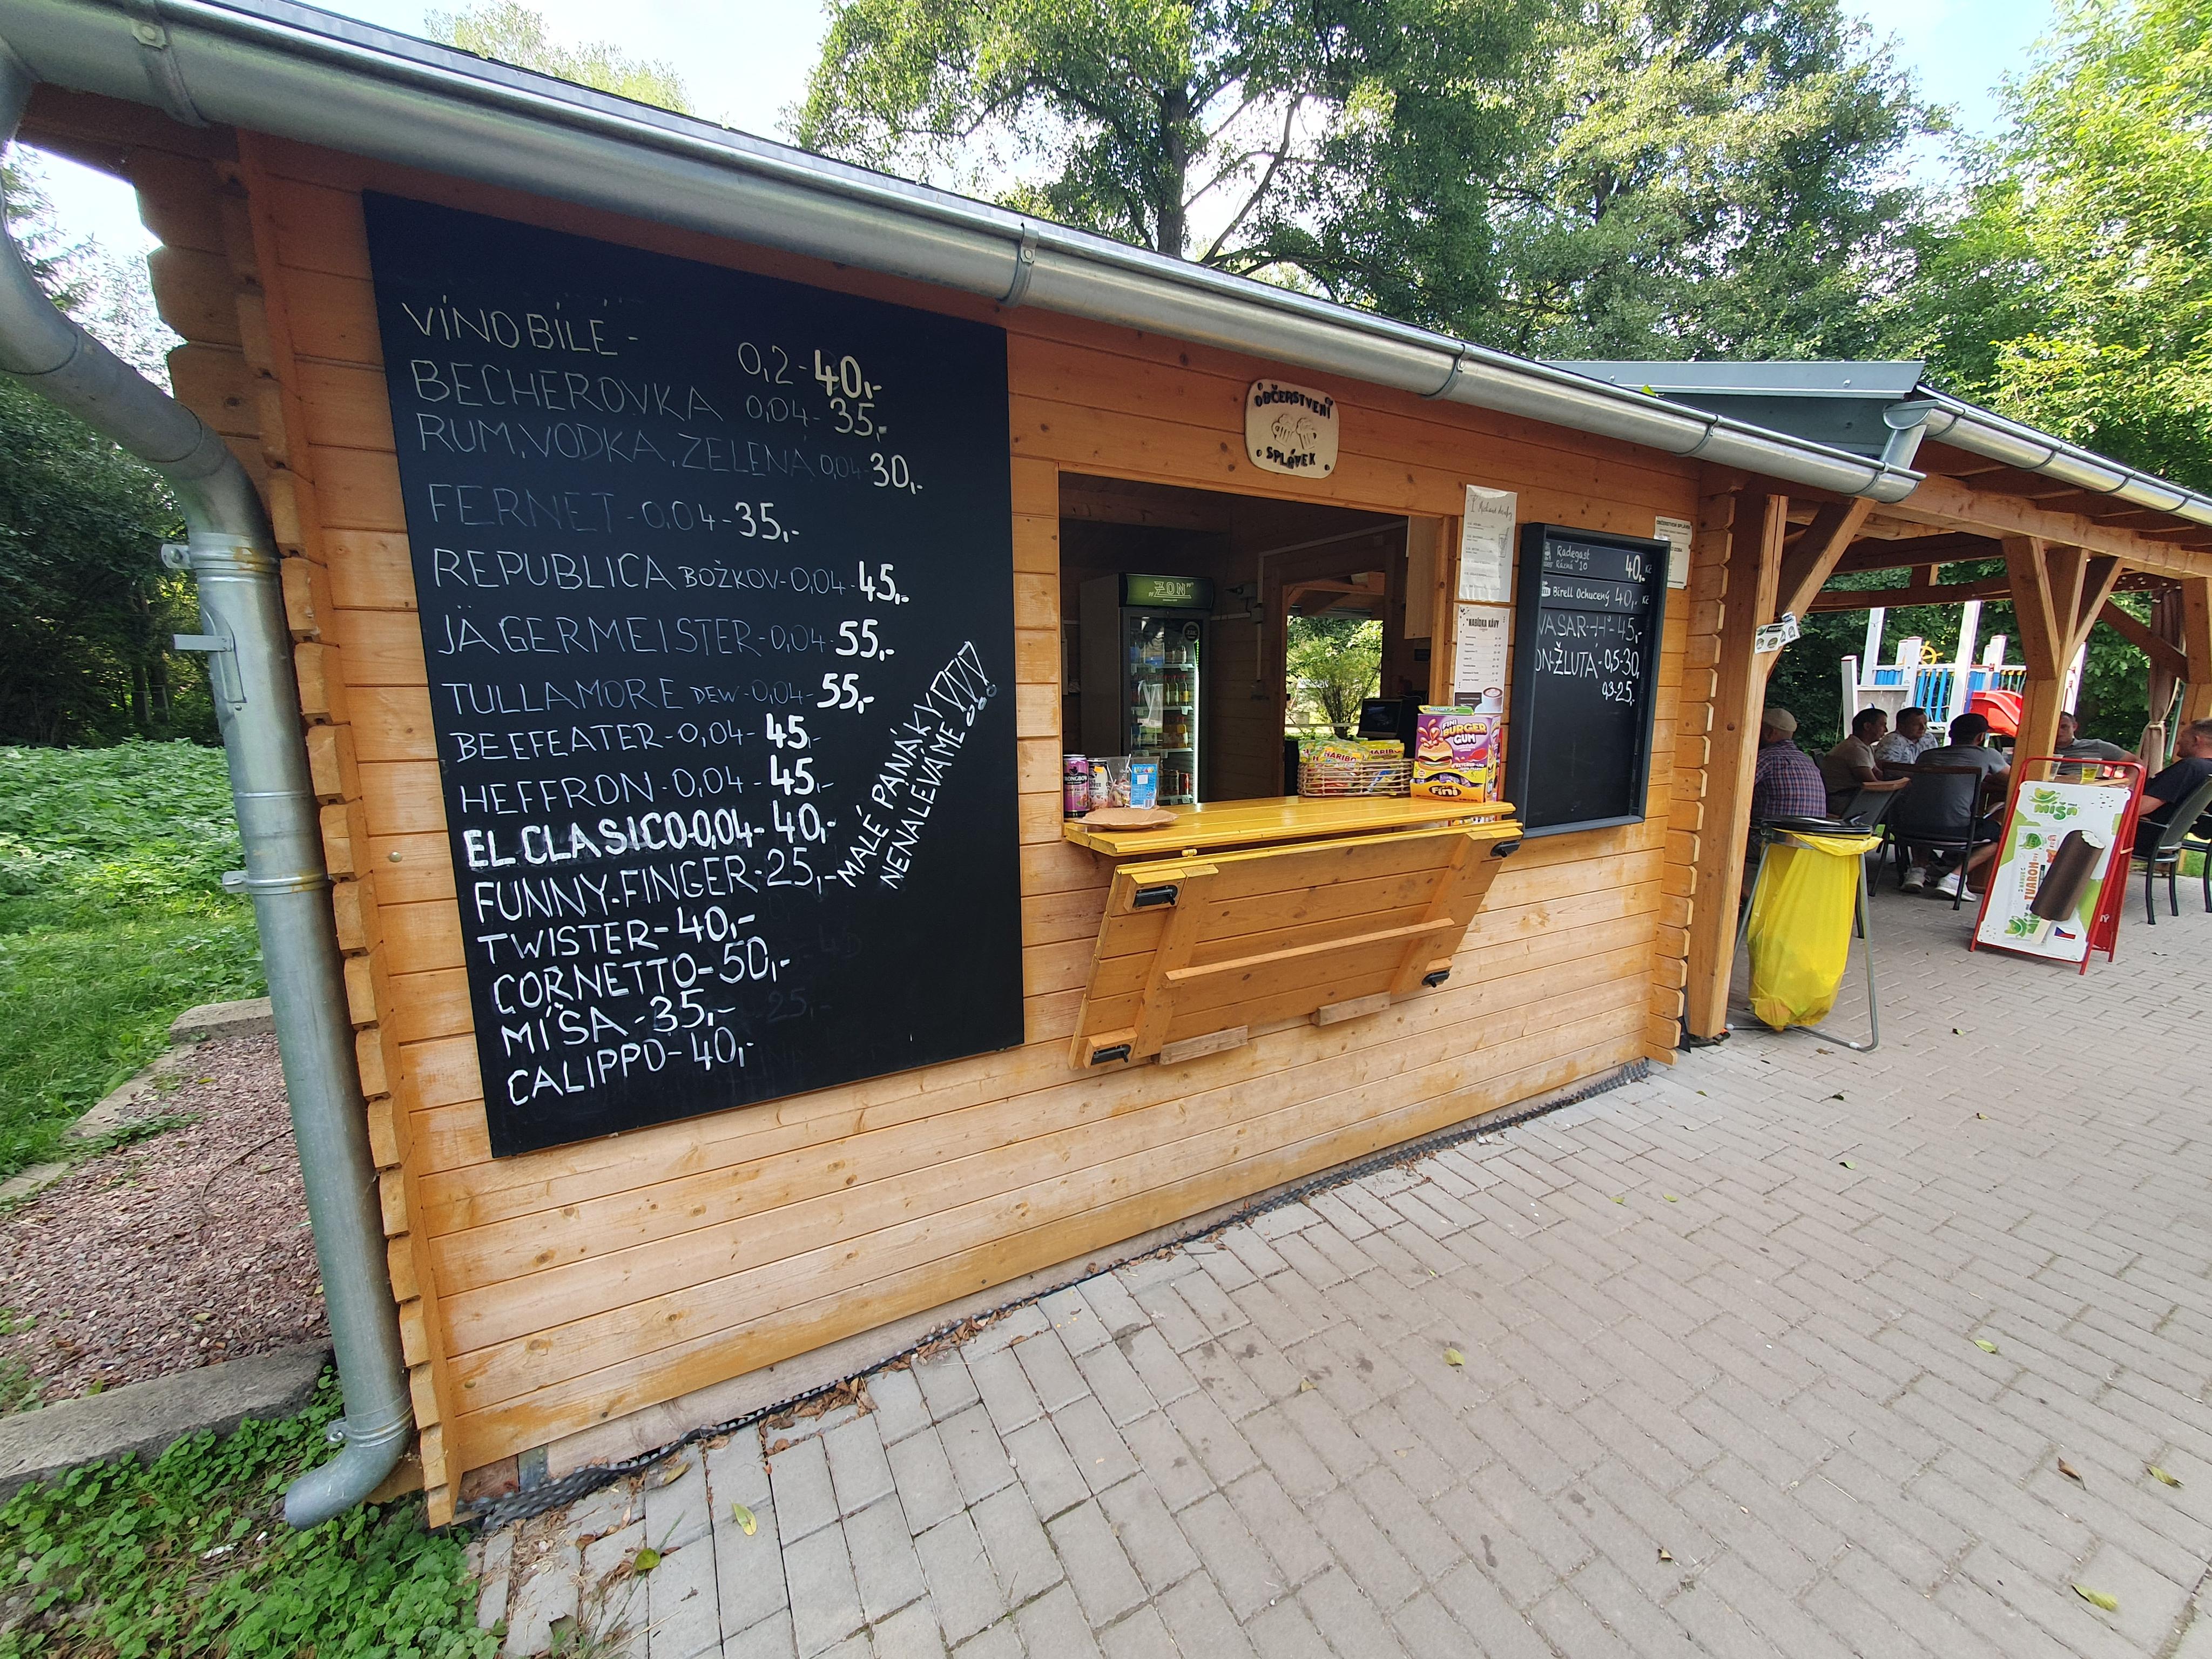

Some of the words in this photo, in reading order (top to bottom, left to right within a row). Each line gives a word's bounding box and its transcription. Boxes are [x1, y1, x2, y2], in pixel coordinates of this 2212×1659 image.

[411, 360, 724, 421] BECHEROVKA
[1255, 384, 1333, 419] OBČERSTVENÍ
[1266, 447, 1316, 469] SPLÁVEK
[1557, 545, 1590, 563] Radegast
[434, 549, 677, 590] REPUBLICA
[1579, 561, 1588, 571] 10
[1553, 586, 1574, 598] Birell
[1576, 588, 1609, 607] Ochucený
[1468, 617, 1487, 628] NABÍDKA
[1488, 618, 1499, 628] KÁVY
[441, 678, 684, 714] TULLAMORE
[1442, 719, 1457, 729] FINI
[1442, 723, 1487, 738] BURGER
[1453, 733, 1476, 745] GUM
[1432, 786, 1458, 796] Fini
